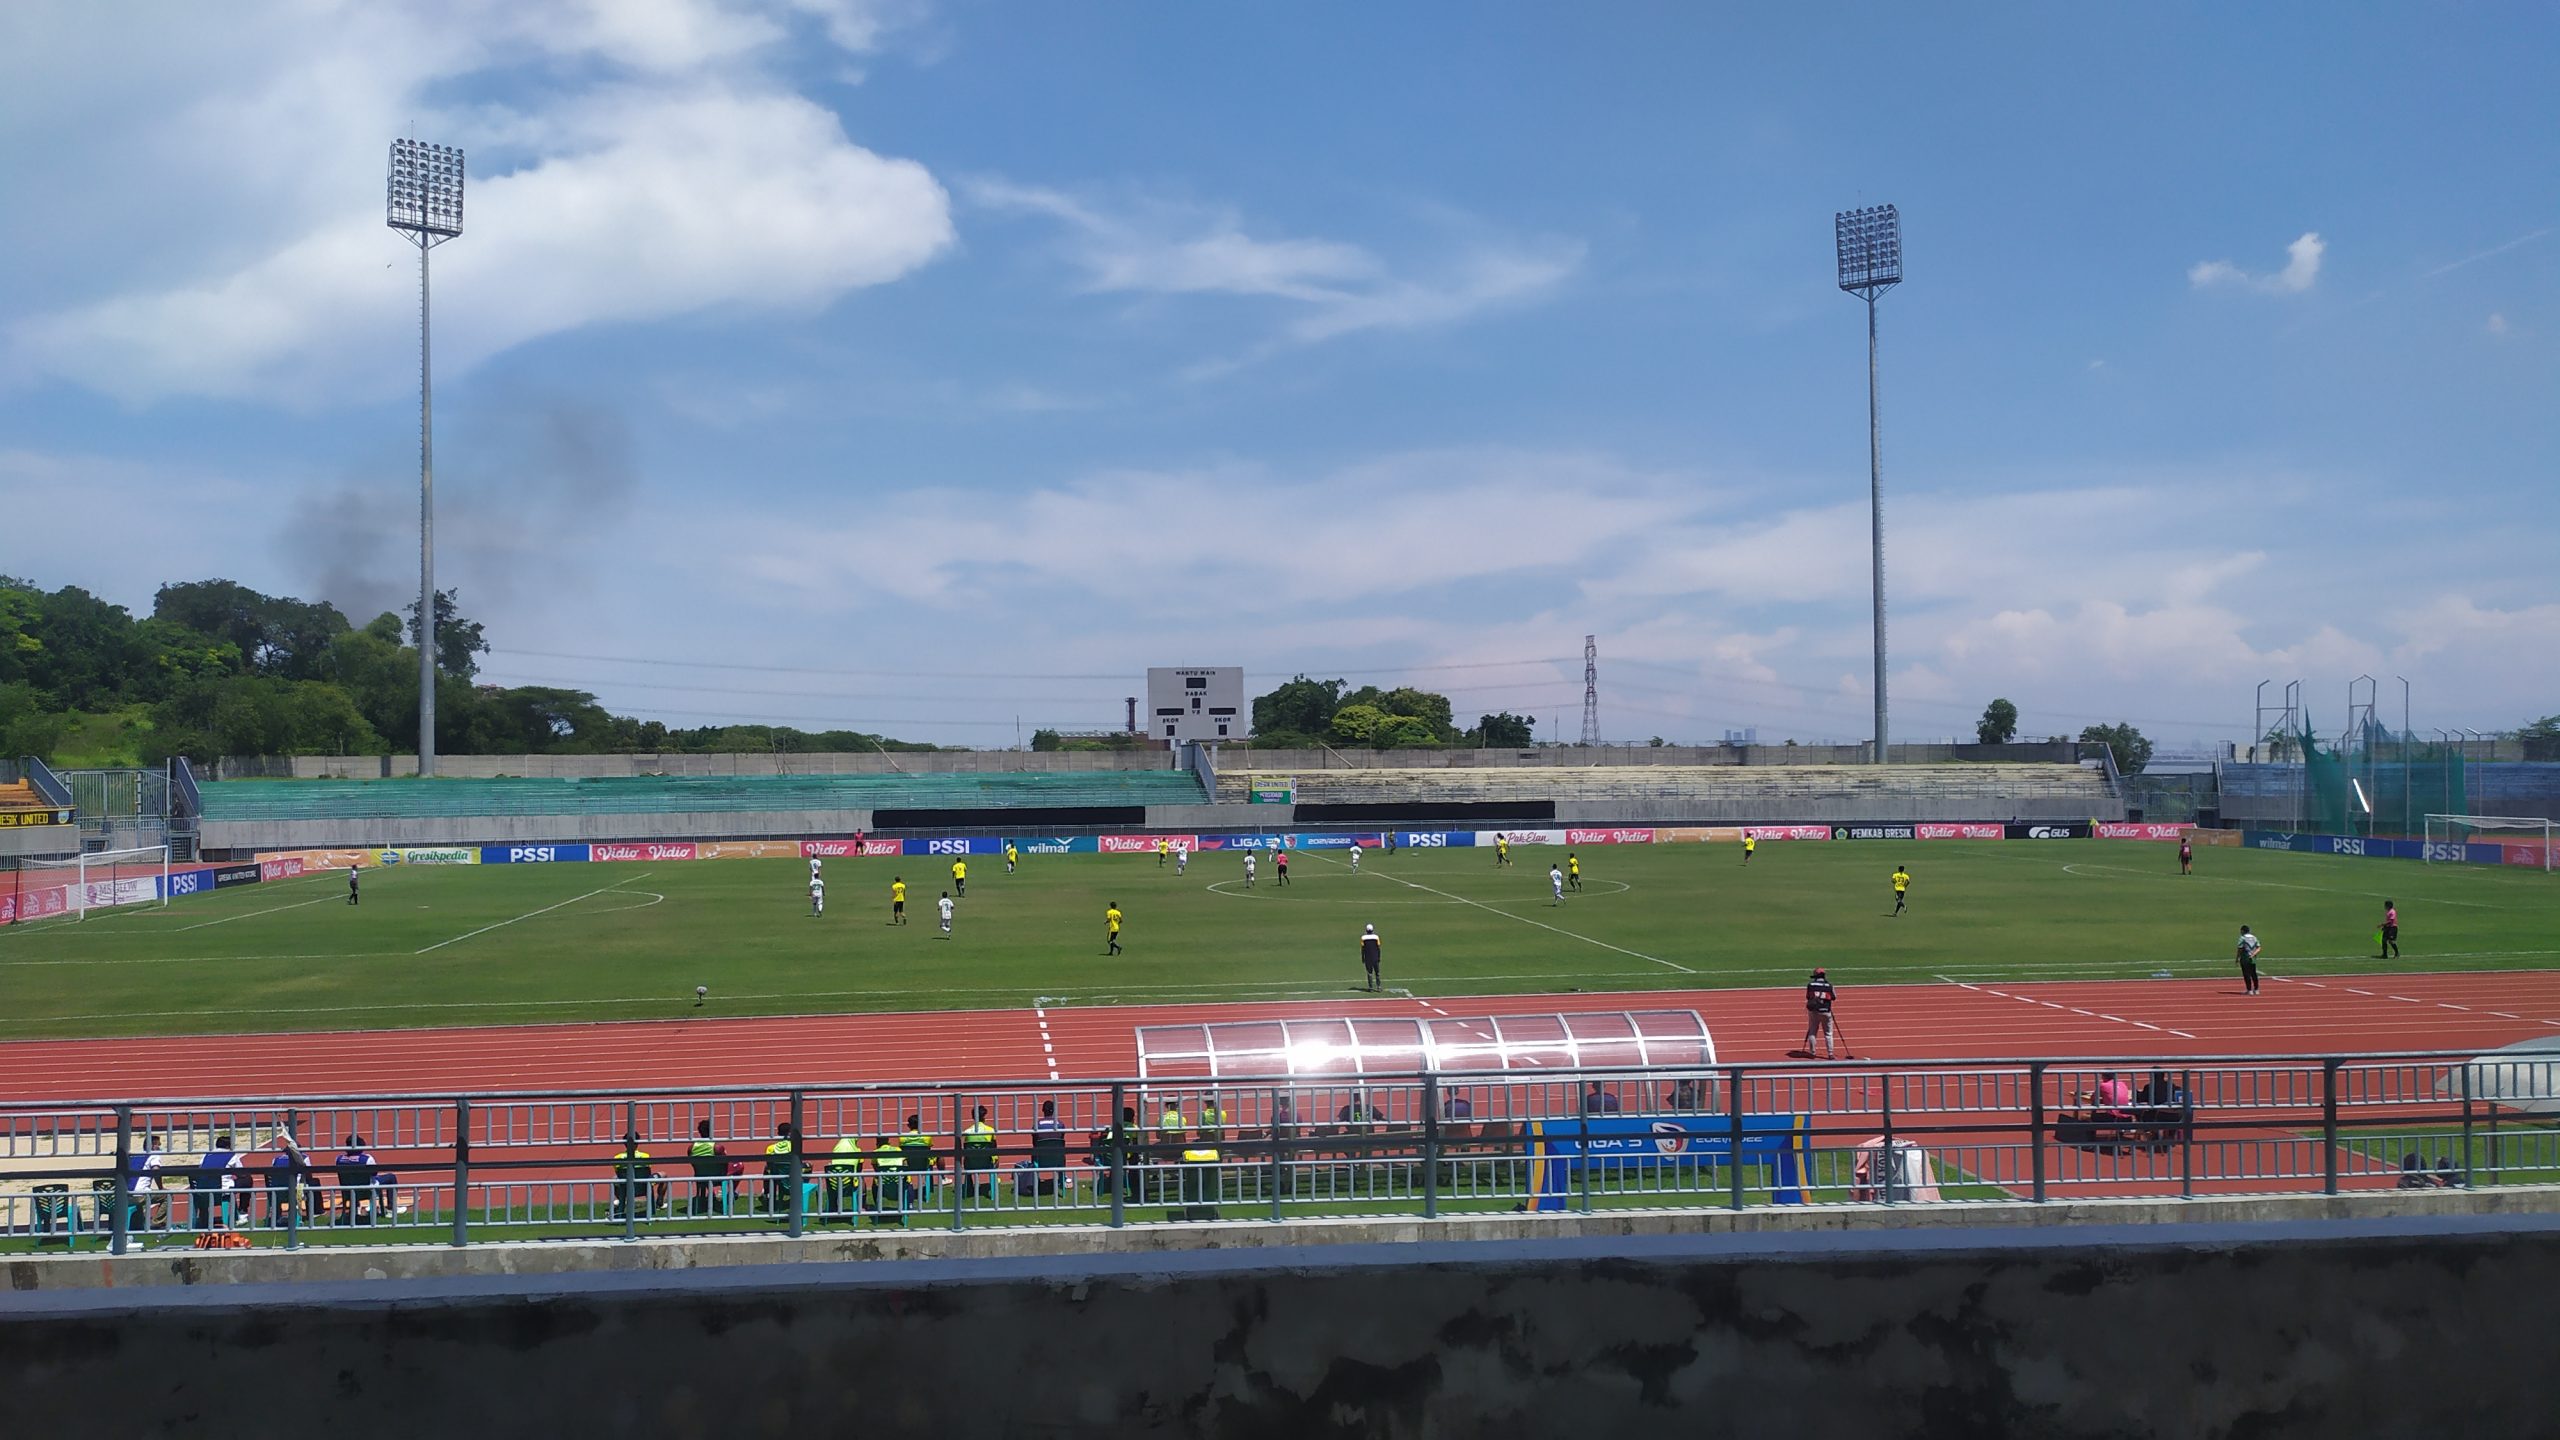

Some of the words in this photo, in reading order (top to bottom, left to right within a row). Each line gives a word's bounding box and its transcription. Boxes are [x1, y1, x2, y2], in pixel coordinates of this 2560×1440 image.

[21, 813, 49, 825] UNITED
[1571, 831, 1607, 843] Vidio
[1613, 830, 1649, 843] Vidio
[1750, 829, 1784, 841] Vidio
[1790, 828, 1826, 840] Vidio
[1851, 829, 1883, 839] PEMKAB
[1884, 828, 1912, 838] GRESIK
[1920, 826, 1956, 838] Vidio
[1962, 825, 1998, 838] Vidio
[2050, 828, 2070, 838] GUS
[2099, 825, 2140, 838] Vidio
[2147, 825, 2181, 838] Vidi
[1105, 837, 1145, 850] Vidio
[1151, 838, 1191, 851] Vdio
[1231, 838, 1262, 847] LIGA
[1307, 837, 1351, 845] 2021/2022
[1409, 833, 1447, 847] PSSI
[2258, 838, 2292, 850] wilmar
[2333, 838, 2365, 855] PSSI
[597, 845, 640, 860] Vidio
[648, 845, 690, 858] Vidio
[806, 842, 847, 855] Vidio
[929, 840, 970, 854] PSSI
[1027, 843, 1071, 854] wilmar
[2422, 843, 2467, 862] PSSI
[407, 850, 468, 864] Gresikpedia
[510, 847, 555, 863] PSSI
[264, 864, 282, 880] Vidio
[284, 861, 302, 877] Vidio
[173, 873, 198, 895] PSSI
